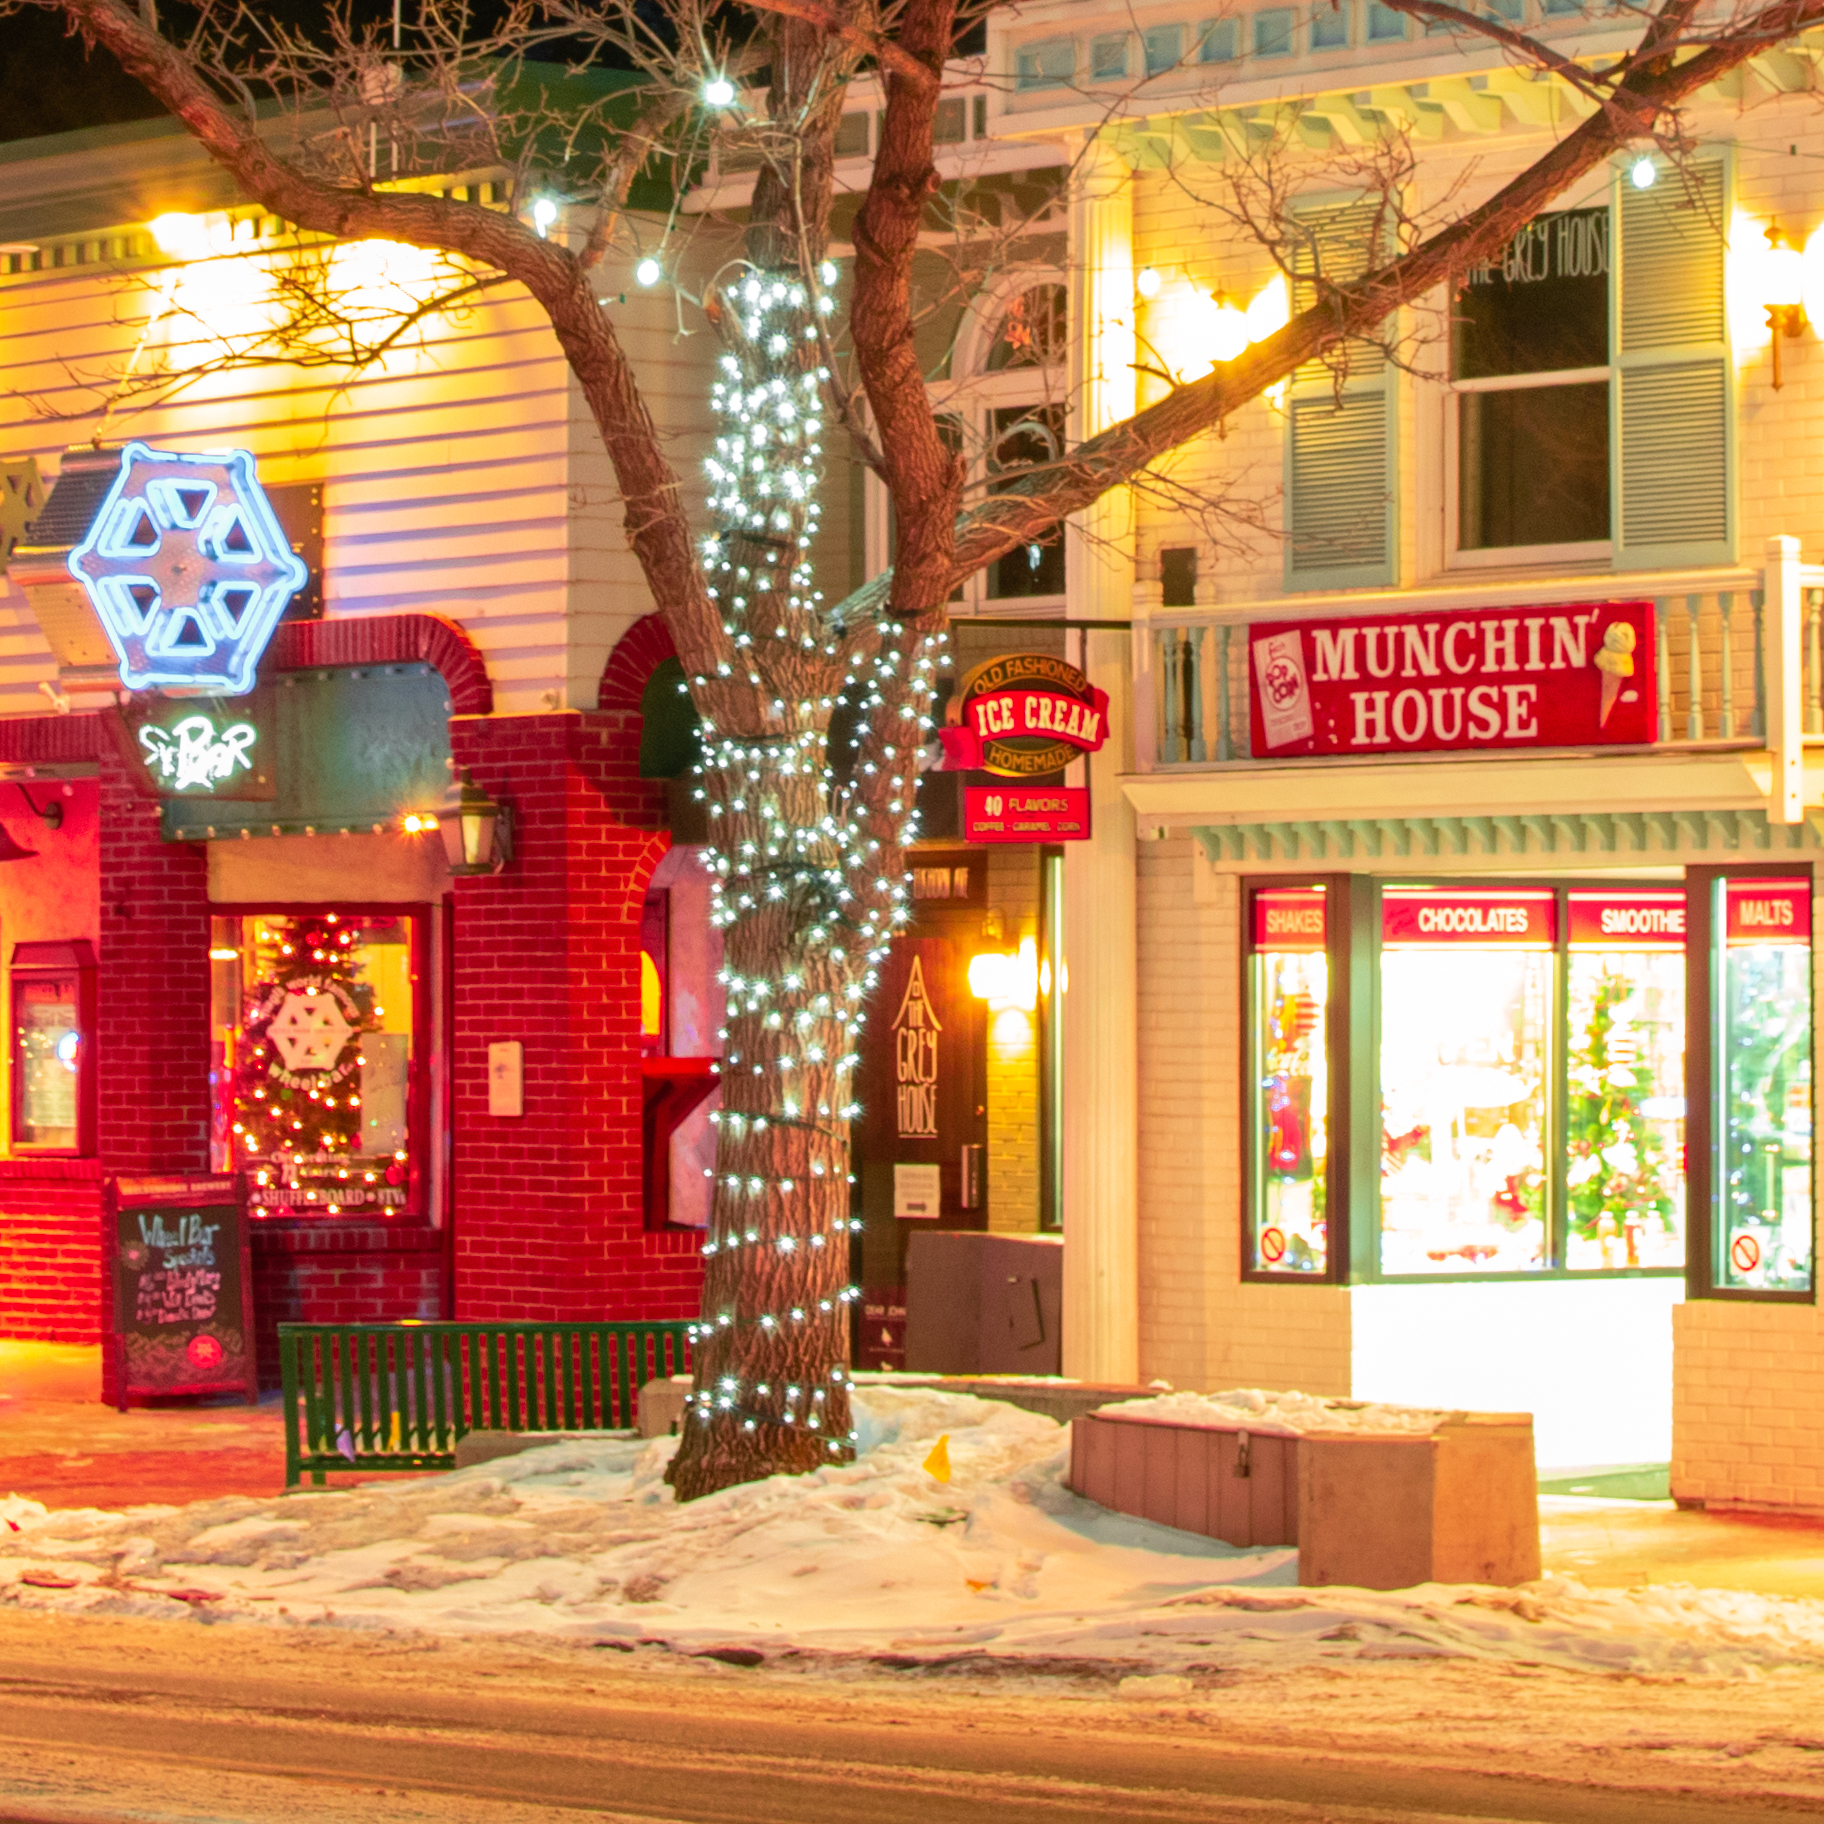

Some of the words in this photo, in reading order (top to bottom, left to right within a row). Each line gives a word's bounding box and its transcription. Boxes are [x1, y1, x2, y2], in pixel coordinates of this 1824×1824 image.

[1311, 608, 1600, 683] MUNCHIN'
[974, 667, 1004, 696] OLD
[1005, 656, 1087, 693] FASHIONED
[975, 696, 1015, 737] ICE
[1025, 695, 1101, 744] CREAM
[1349, 684, 1539, 746] HOUSE
[988, 744, 1076, 773] HOMEMADE
[984, 794, 1004, 817] 40
[1008, 797, 1069, 813] FLAVORS
[1266, 909, 1324, 934] SHAKES
[1418, 907, 1529, 933] CHOCOLATES
[1738, 899, 1795, 926] MALTS
[908, 1000, 925, 1027] THE
[896, 1027, 939, 1084] GREY
[897, 1084, 939, 1134] HOUSE
